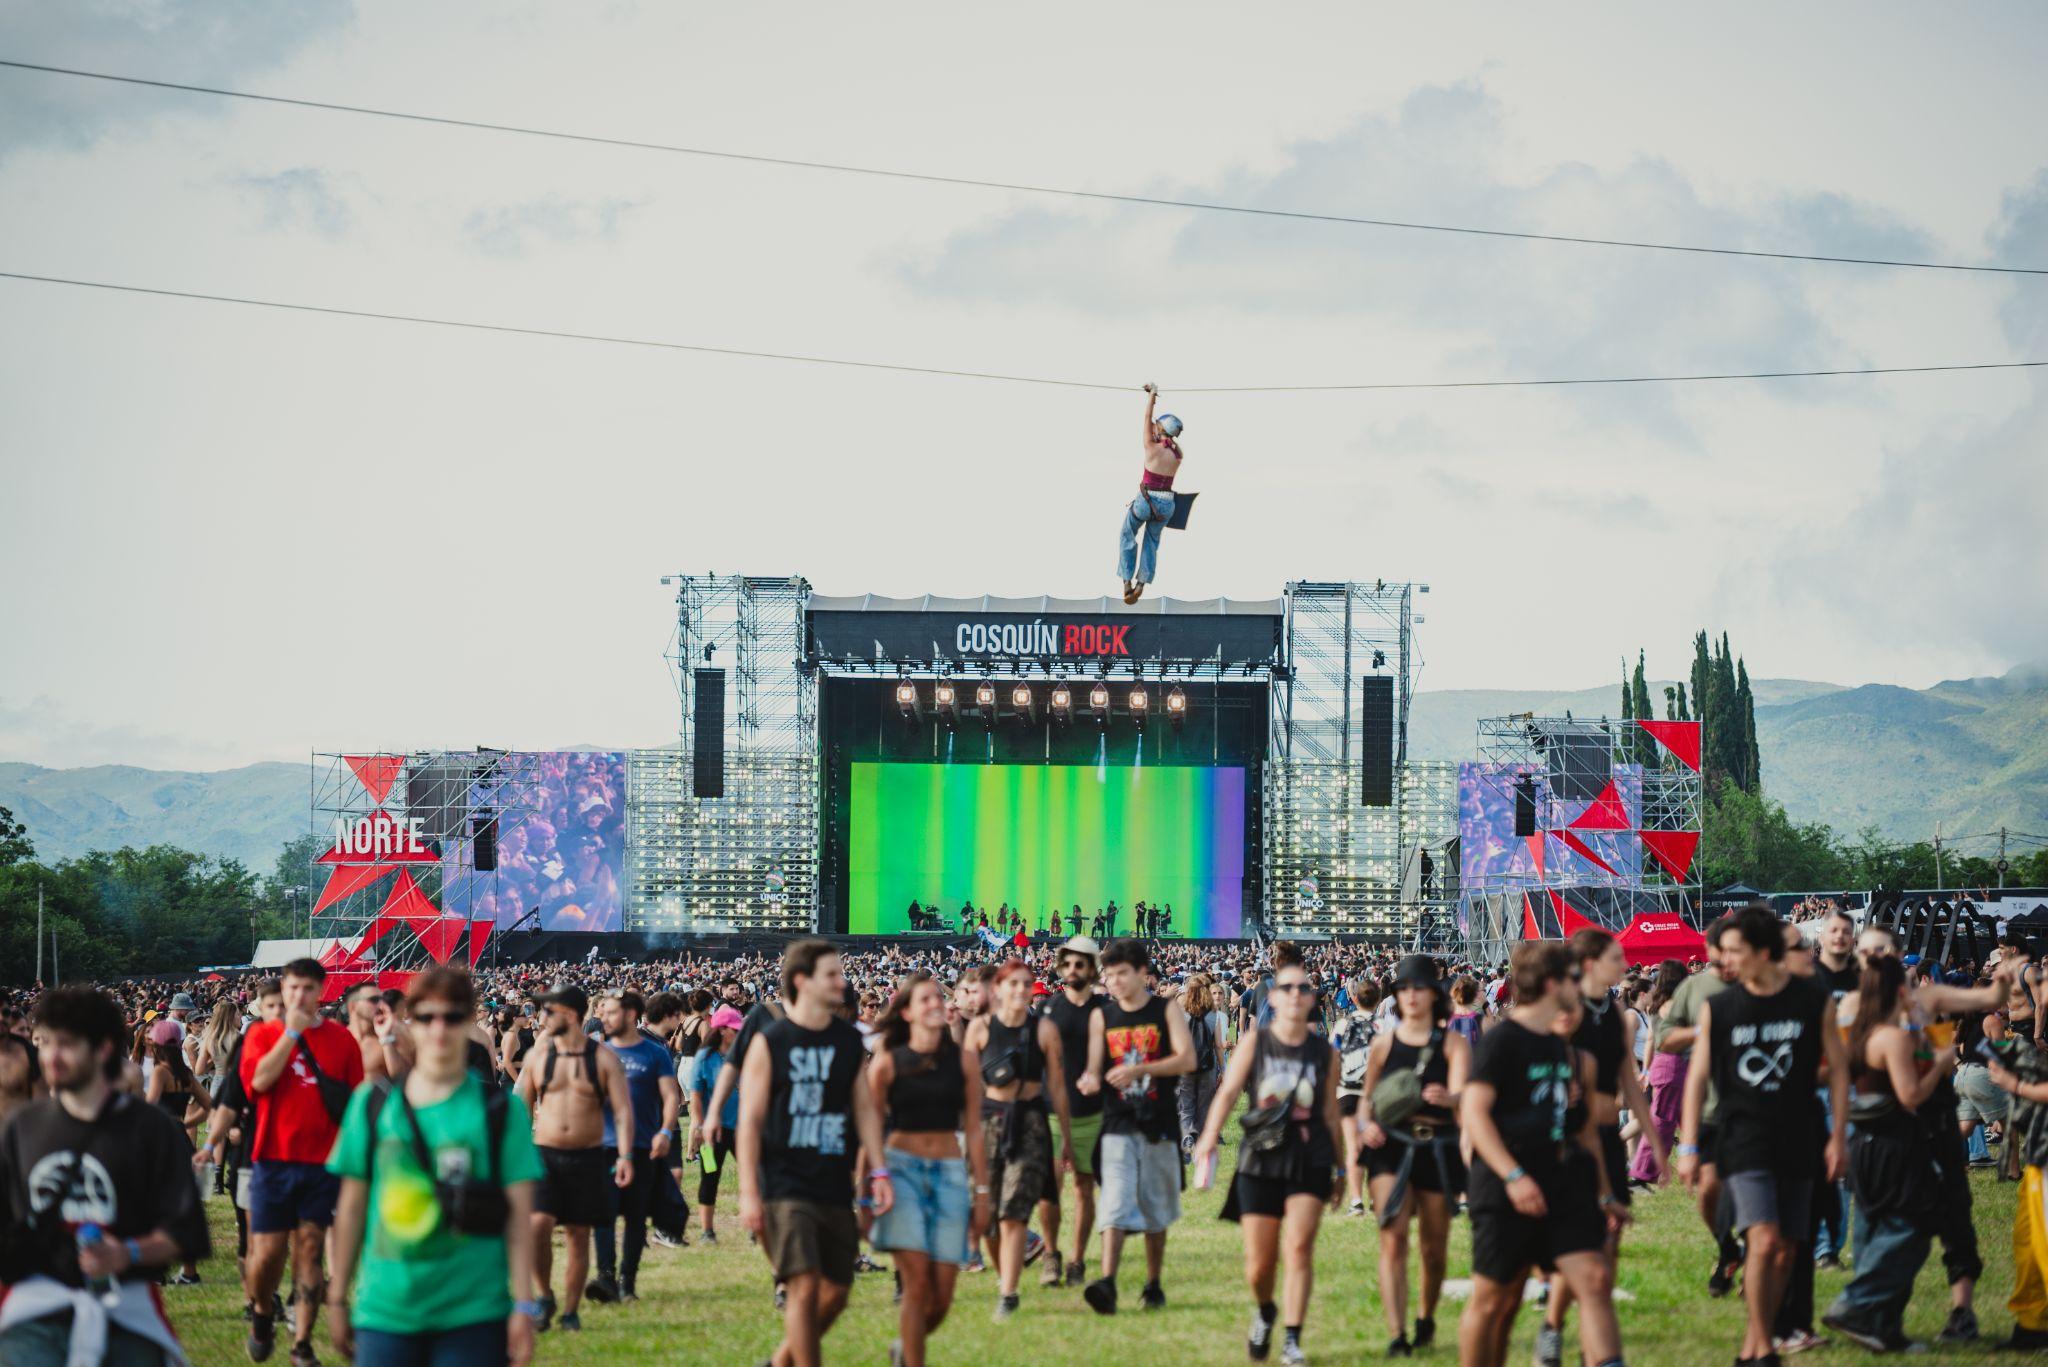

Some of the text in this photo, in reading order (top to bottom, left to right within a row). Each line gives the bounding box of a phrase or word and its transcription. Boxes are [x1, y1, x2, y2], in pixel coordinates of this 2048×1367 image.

[956, 619, 1130, 655] COSQUÍN ROCK
[335, 816, 425, 854] NORTE
[788, 1045, 836, 1081] SAY
